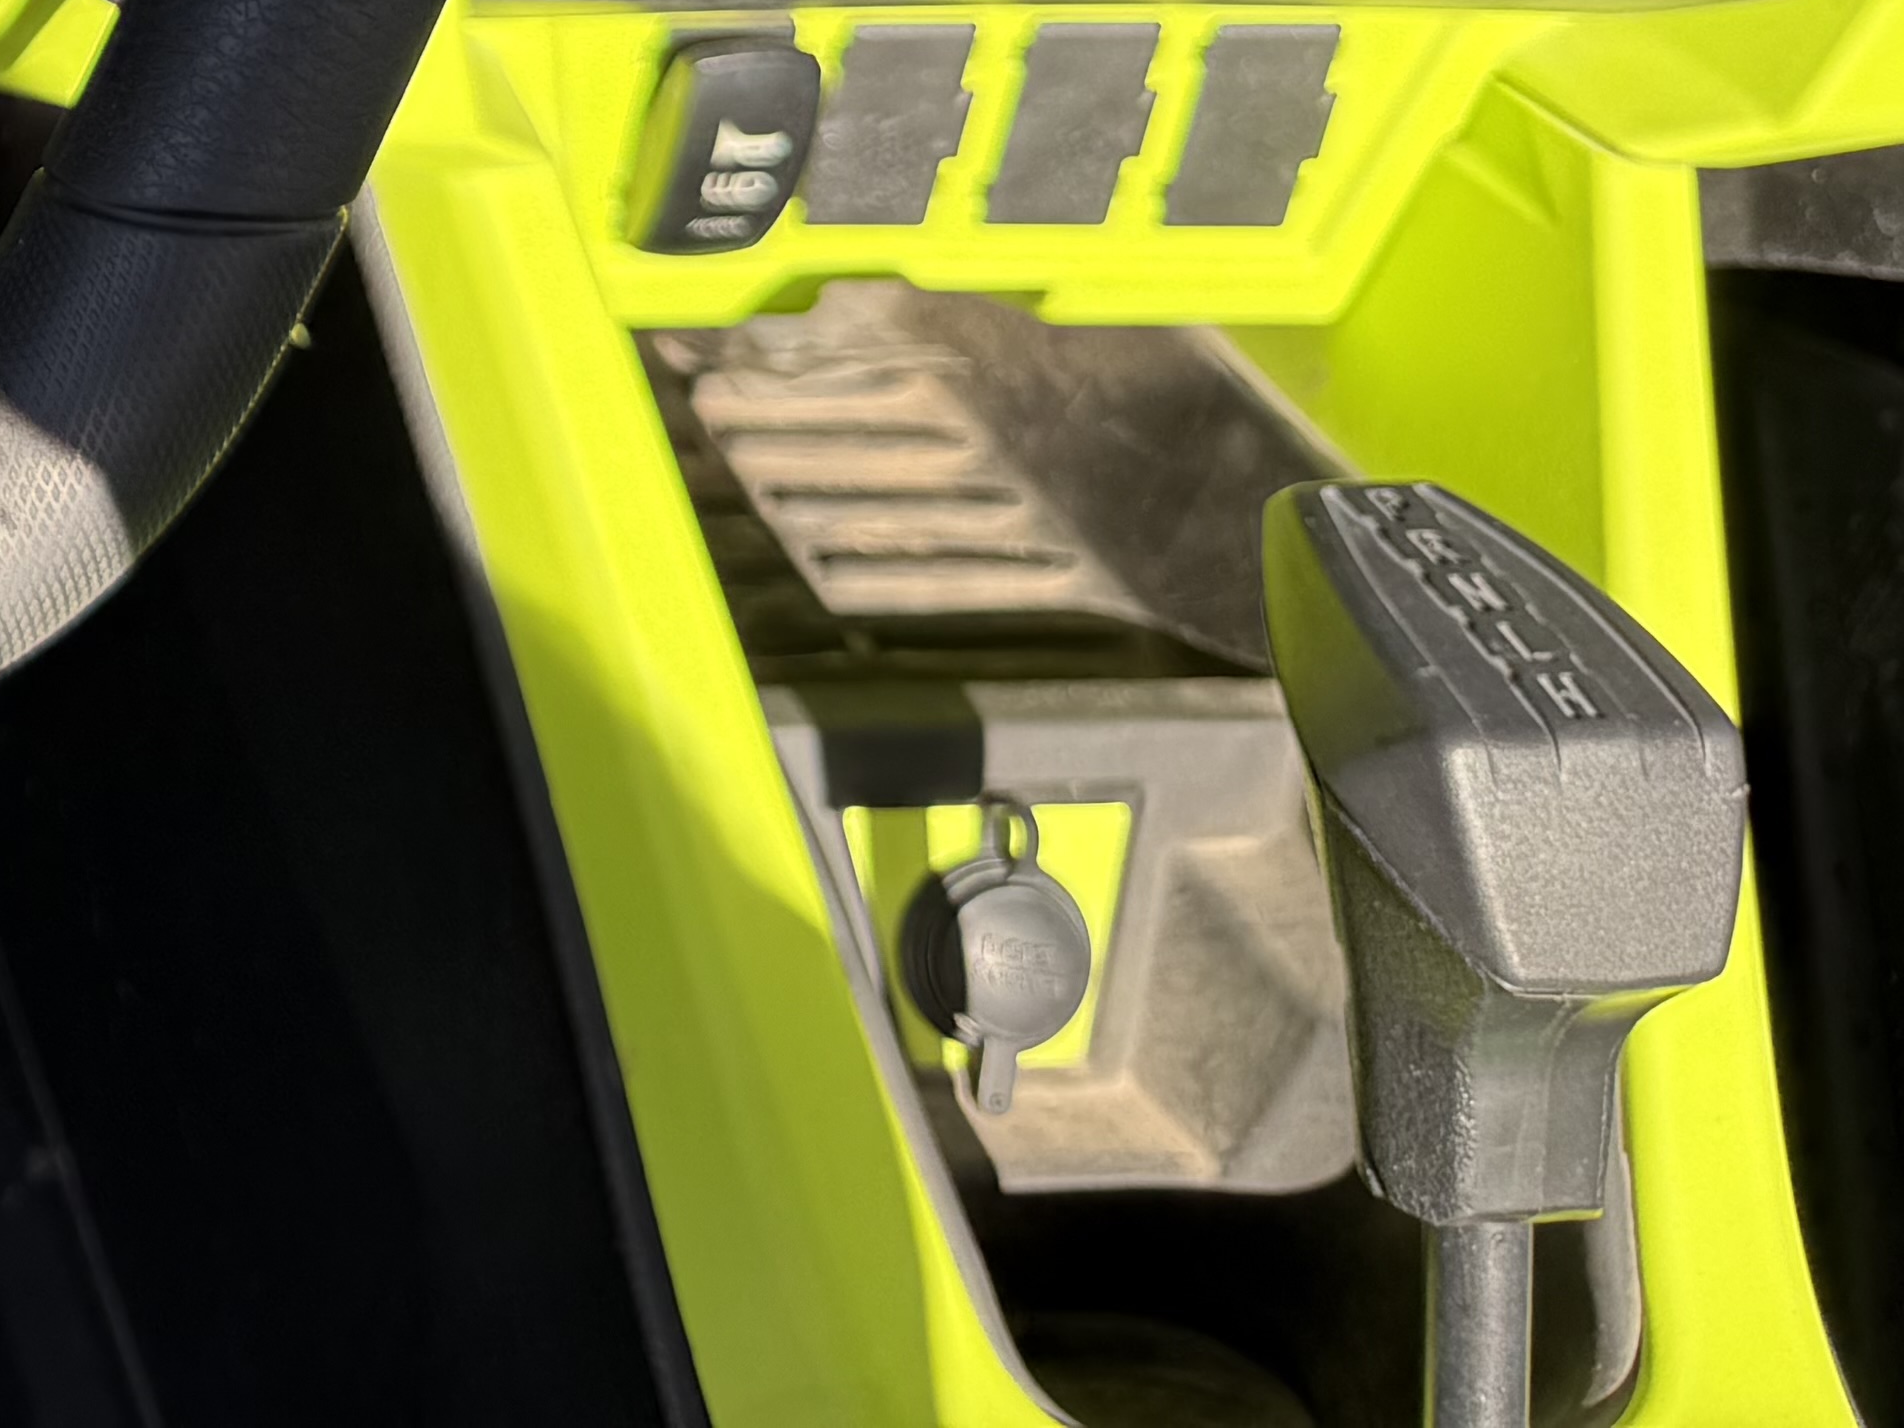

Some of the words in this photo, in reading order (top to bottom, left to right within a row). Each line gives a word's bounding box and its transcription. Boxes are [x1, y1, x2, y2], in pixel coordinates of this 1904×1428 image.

[1447, 572, 1508, 611] N
[1496, 620, 1554, 662] L
[1535, 671, 1598, 719] H
